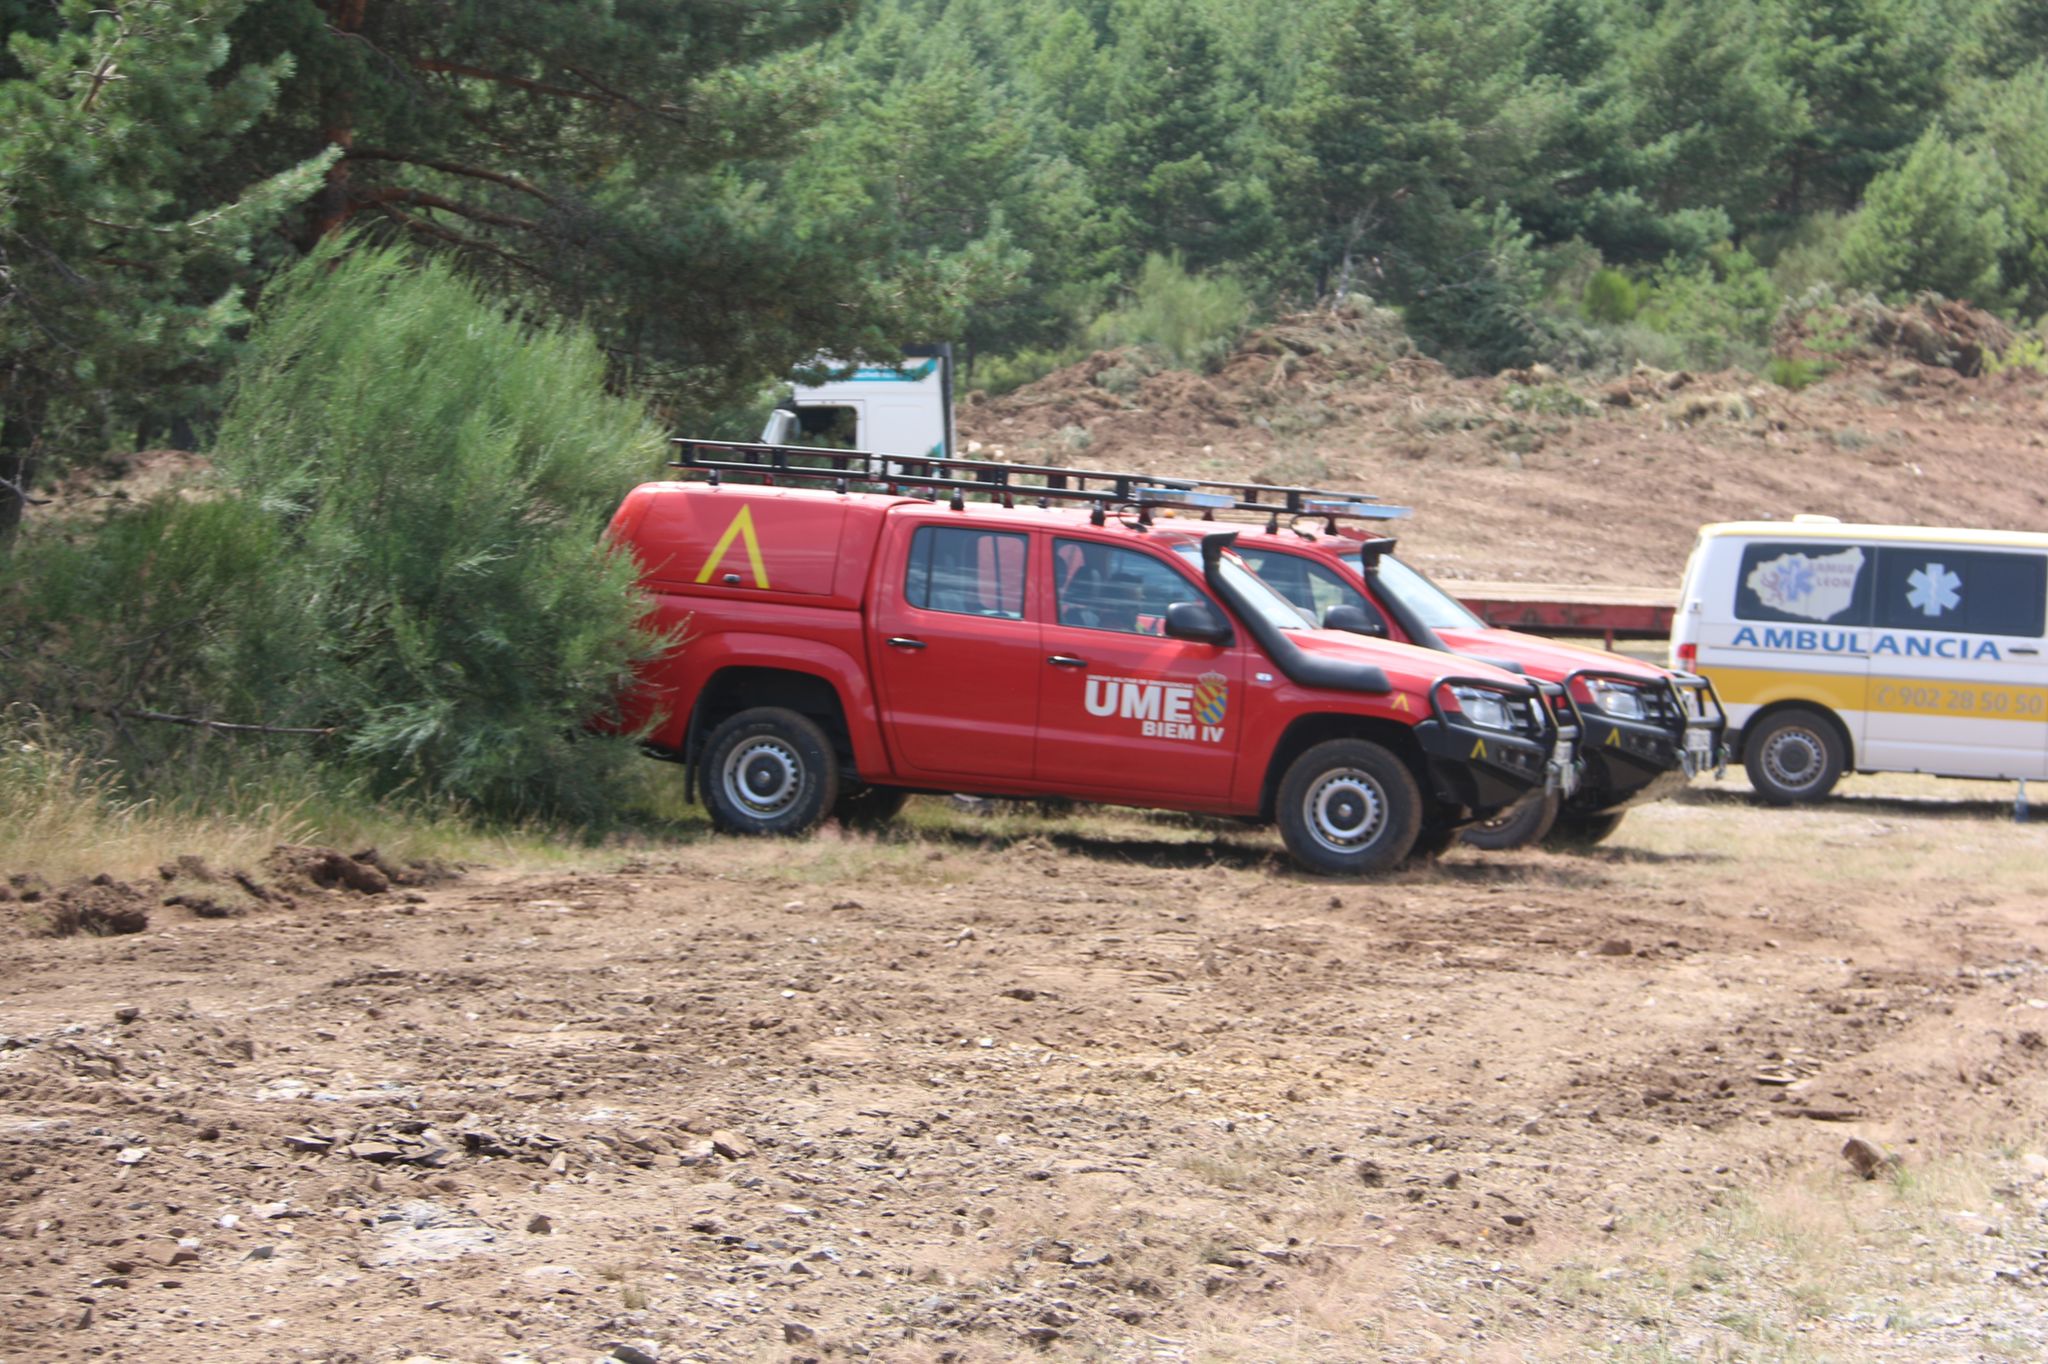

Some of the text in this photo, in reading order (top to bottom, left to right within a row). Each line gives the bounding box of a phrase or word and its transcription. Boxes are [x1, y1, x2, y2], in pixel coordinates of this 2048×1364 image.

[1732, 626, 2002, 660] AMBULANCIA
[1085, 680, 1194, 723] UME
[1899, 686, 2043, 715] 902 28 50 50
[1142, 720, 1224, 742] BIEM IV
